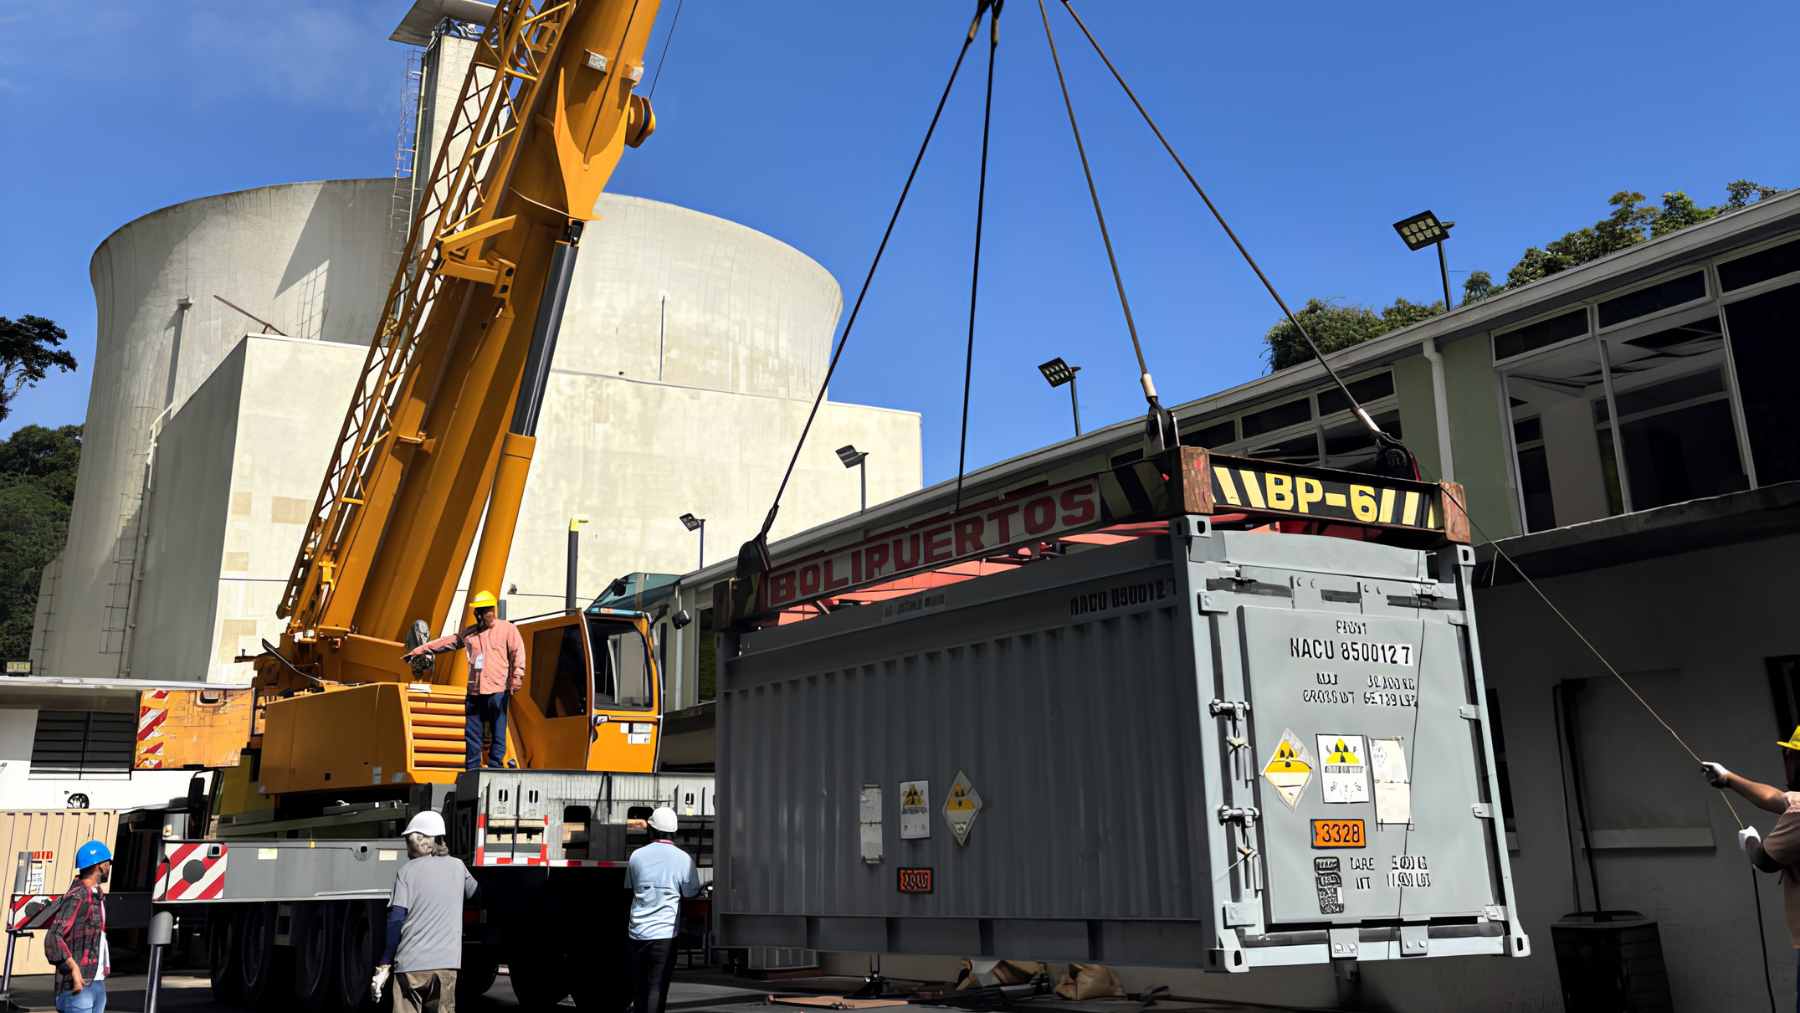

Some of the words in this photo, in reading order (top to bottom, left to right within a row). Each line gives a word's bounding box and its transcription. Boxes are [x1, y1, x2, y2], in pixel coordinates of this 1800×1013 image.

[1265, 472, 1377, 522] BP-6
[769, 484, 1097, 600] BOLIPUERTOS
[1290, 638, 1334, 660] NACU
[1321, 823, 1360, 843] 3328
